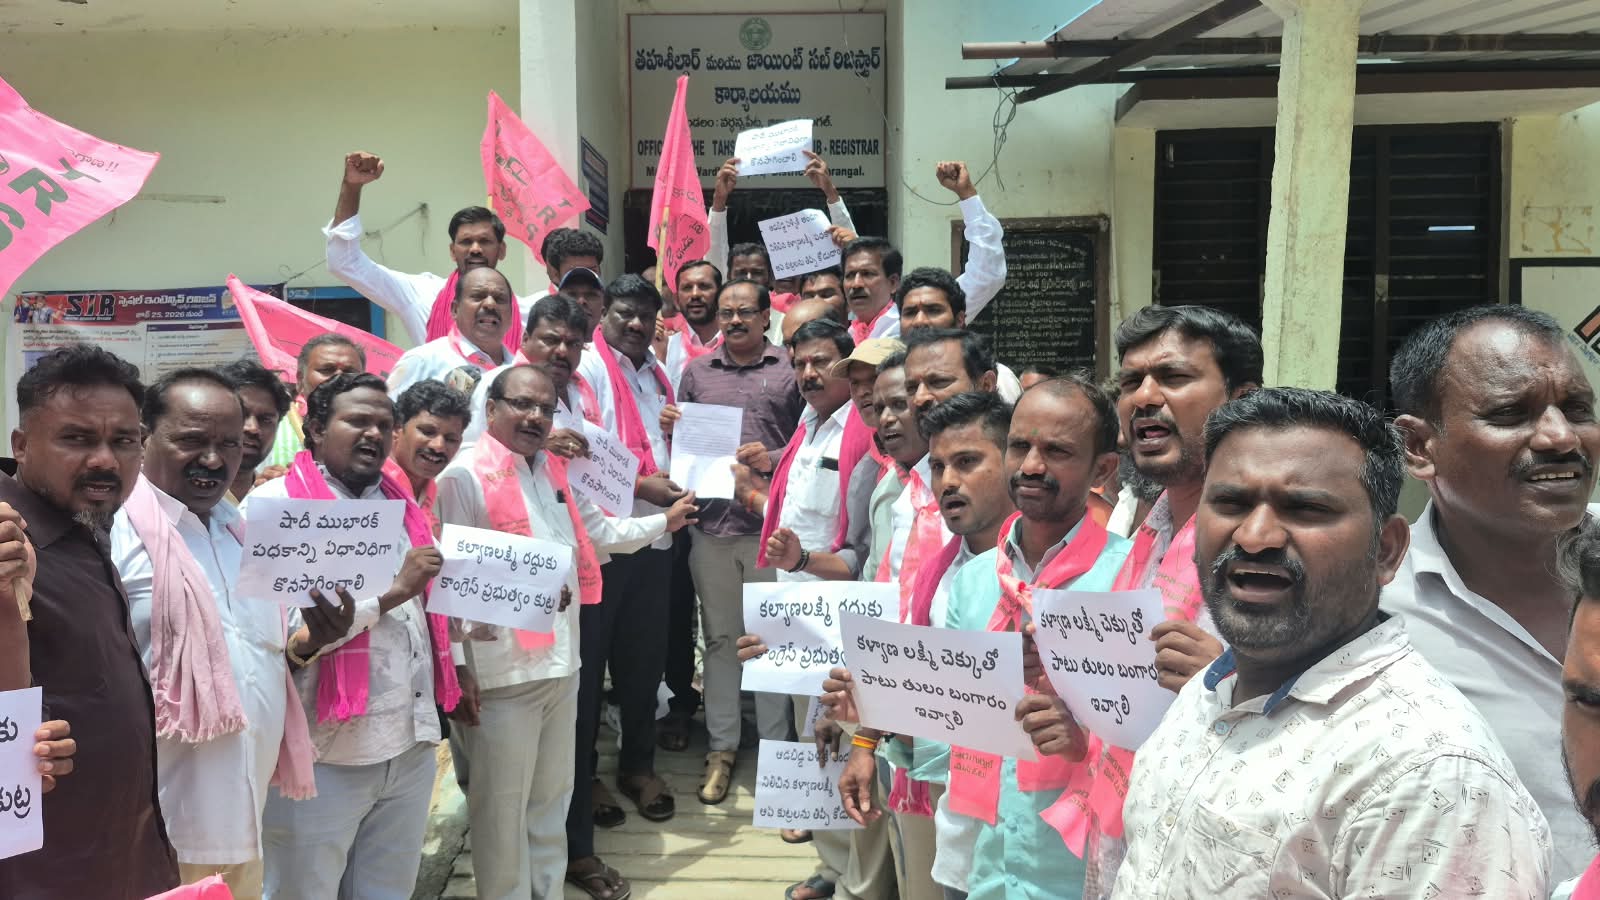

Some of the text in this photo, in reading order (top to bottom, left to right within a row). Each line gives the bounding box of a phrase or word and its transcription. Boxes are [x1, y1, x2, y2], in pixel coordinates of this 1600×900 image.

[706, 55, 741, 70] మరియు
[746, 47, 803, 70] జాయింట్
[808, 47, 831, 70] సబ్
[714, 81, 800, 112] కార్యాలయము
[688, 118, 714, 128] ండలం
[638, 139, 664, 156] OFFIC
[692, 139, 705, 156] HE
[830, 139, 879, 155] REGISTRAR
[63, 294, 116, 316] SIR
[279, 510, 380, 531] షాదీ ముభారక్
[523, 552, 557, 575] రద్దుకు
[440, 576, 556, 614] కాంగ్రెస్ ప్రభుత్వం కుట్ర
[1100, 608, 1144, 645] చెక్కుతో
[940, 648, 999, 679] చెక్కుతో
[1050, 649, 1158, 681] పాటు తులం బంగార
[861, 668, 1007, 710] పాటు తులం బంగారం
[914, 705, 964, 730] ఇవ్వాలి
[1091, 694, 1130, 724] ఇవ్వాలి
